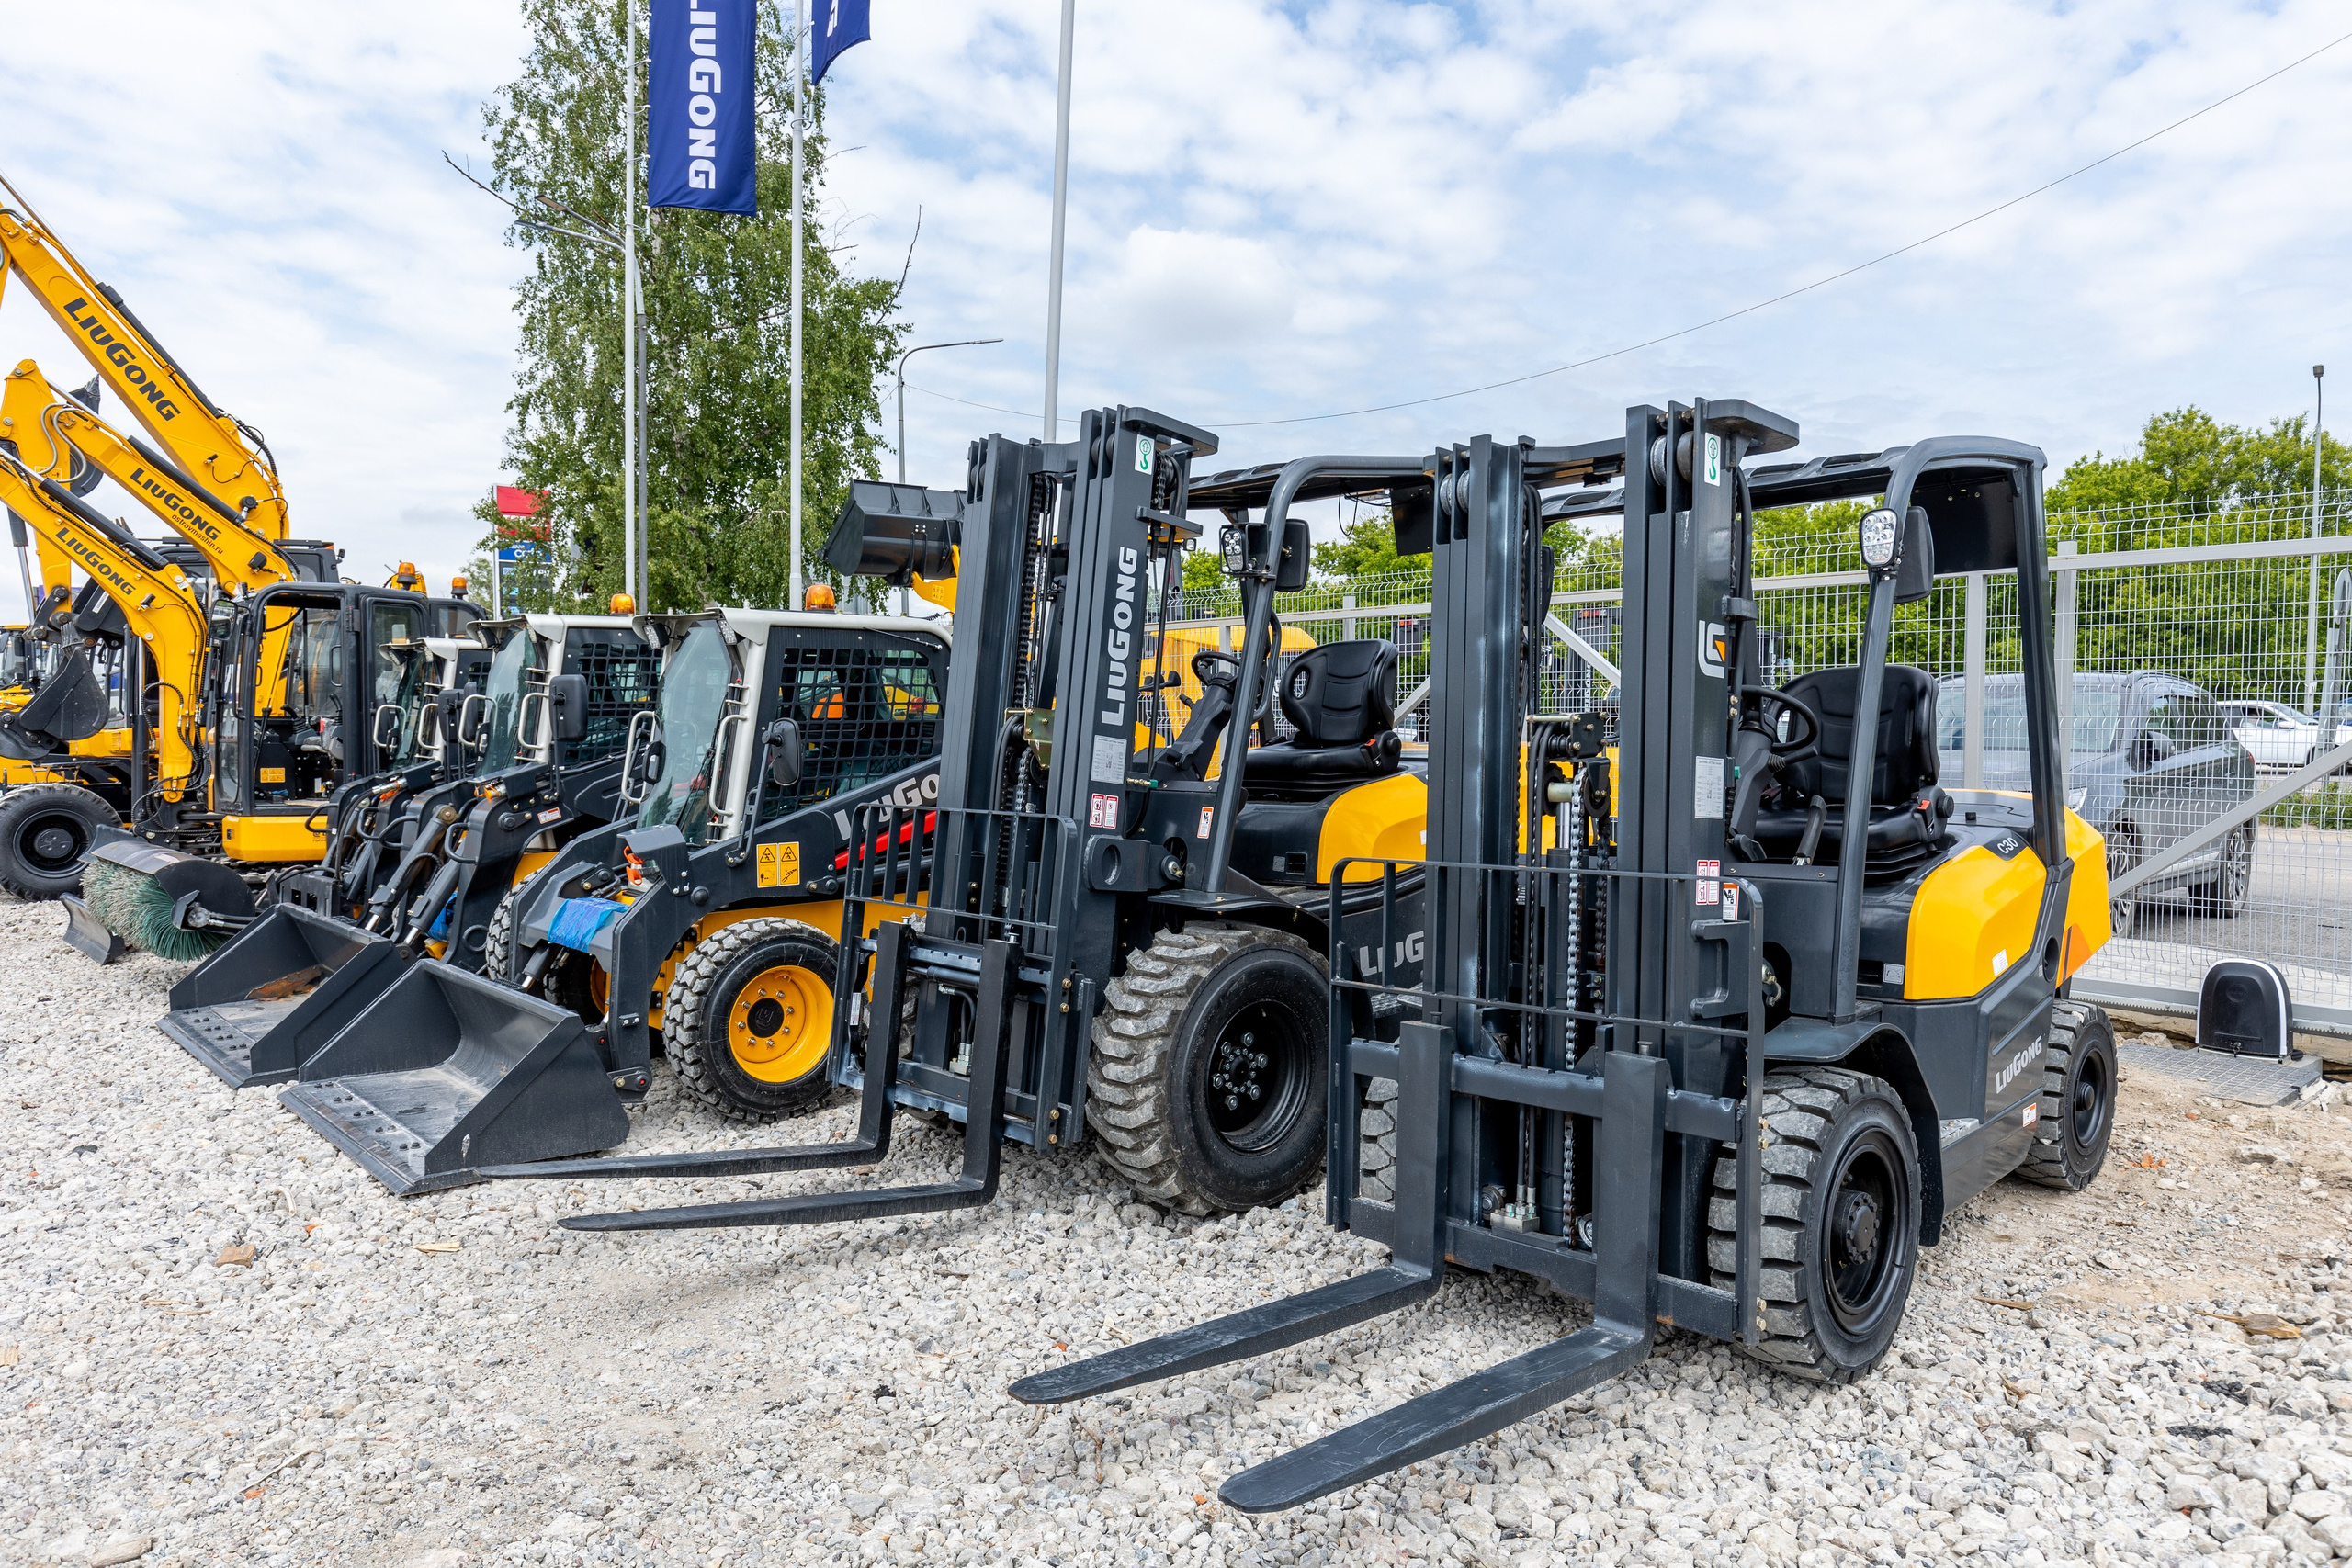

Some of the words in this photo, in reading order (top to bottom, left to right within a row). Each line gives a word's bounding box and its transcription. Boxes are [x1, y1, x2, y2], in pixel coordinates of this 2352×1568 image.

[63, 297, 181, 421] LIUGONG
[130, 468, 221, 540] LIUGONG
[172, 514, 223, 554] ostrovmashin.ru
[55, 527, 136, 595] LIUGONG
[1102, 547, 1138, 726] LIUGONG
[1997, 837, 2018, 854] C30
[1996, 1035, 2042, 1094] LIUGONG
